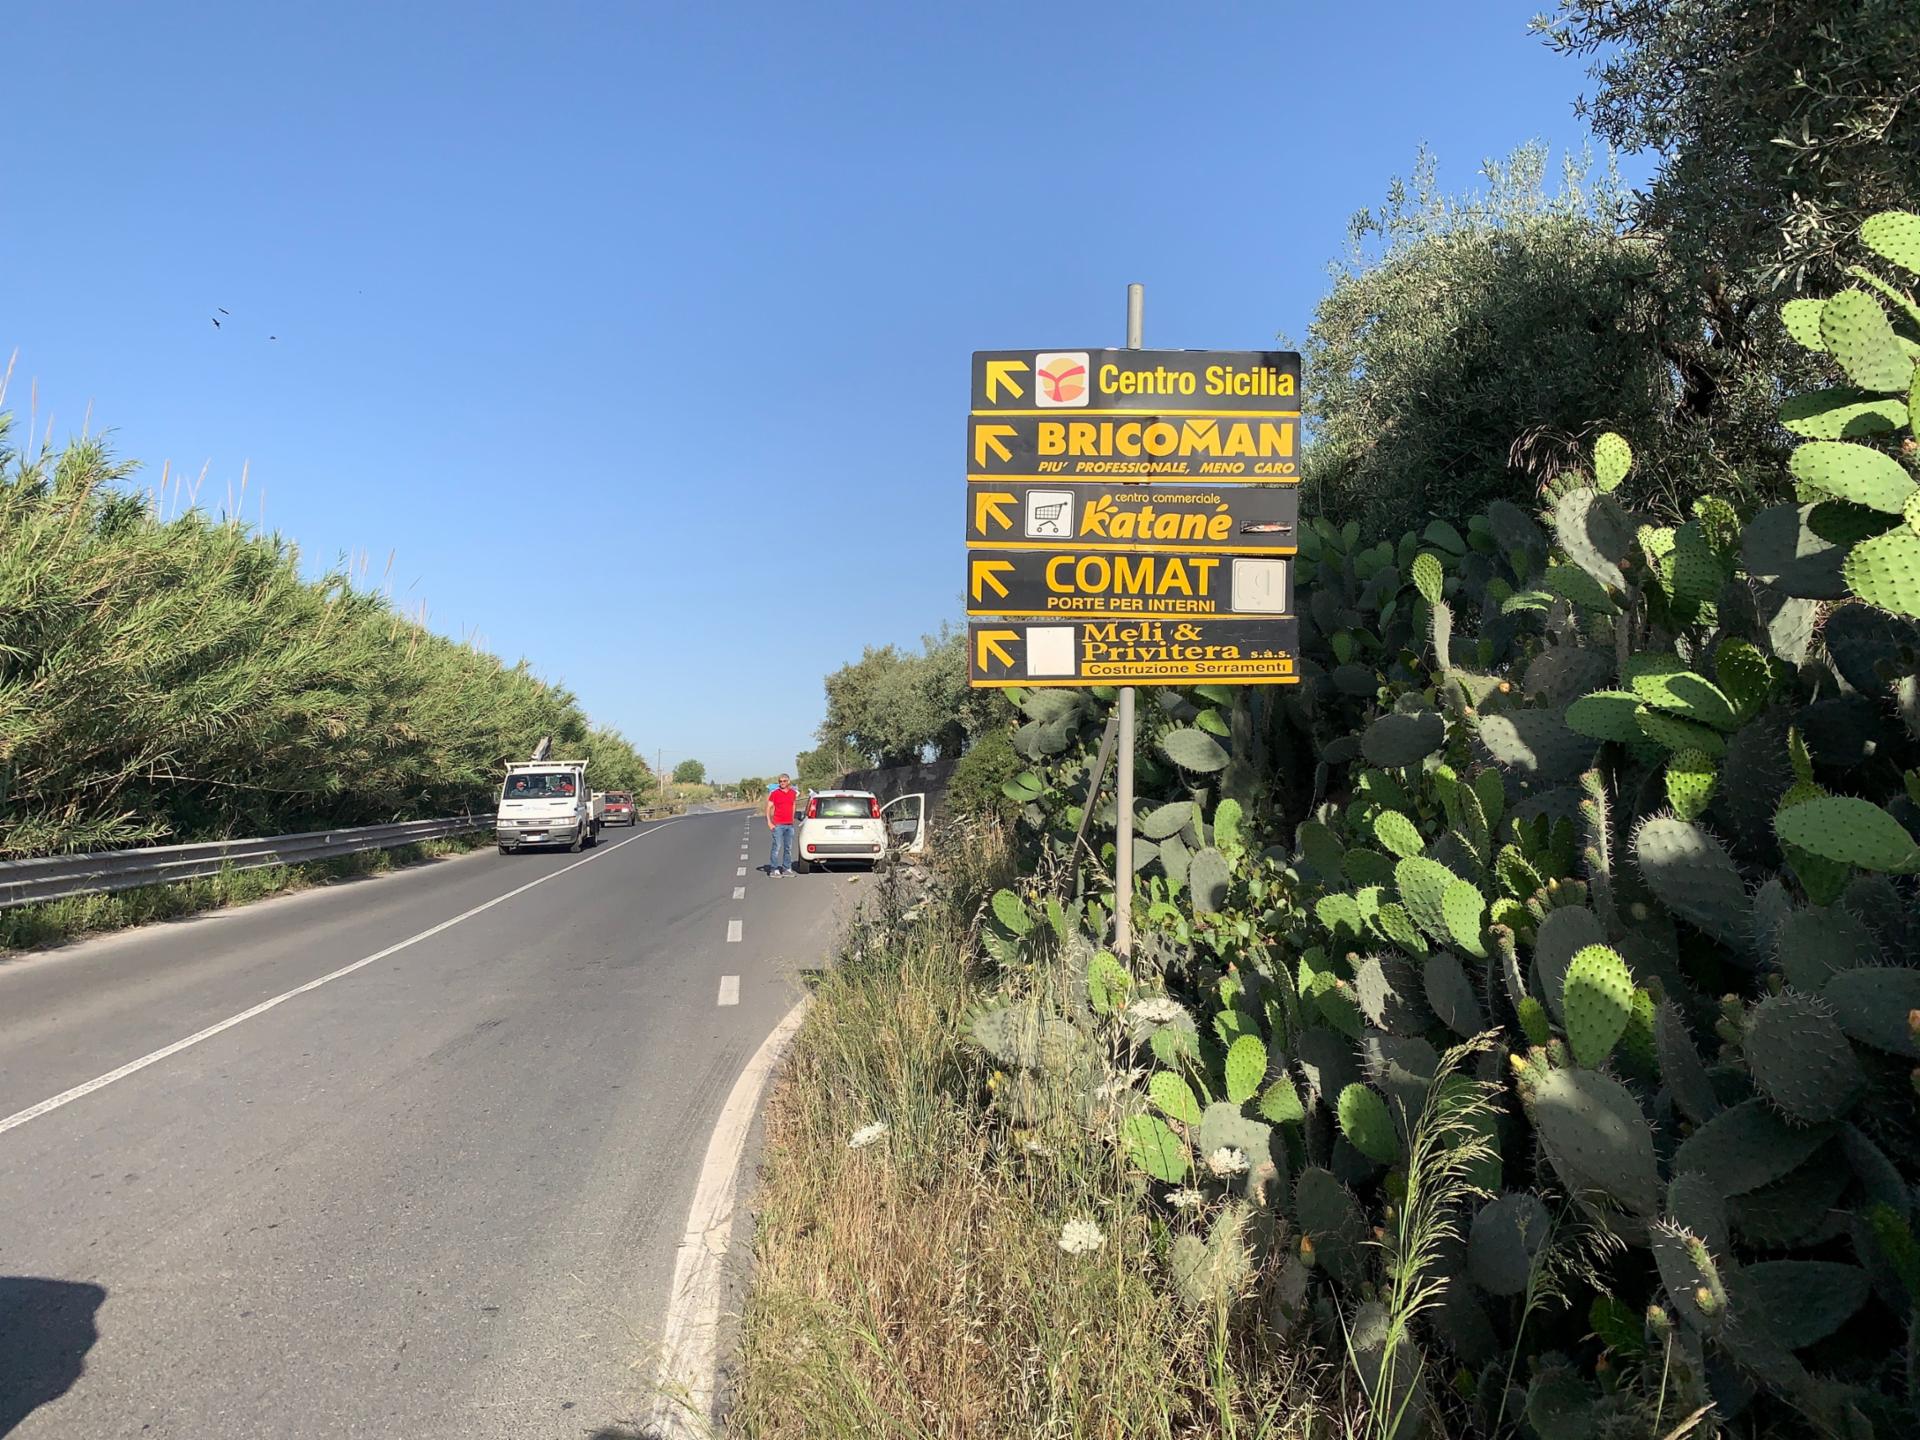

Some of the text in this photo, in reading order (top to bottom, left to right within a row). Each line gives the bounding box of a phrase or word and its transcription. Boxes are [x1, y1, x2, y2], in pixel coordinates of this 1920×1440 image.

[1099, 364, 1294, 396] Centro Sicilia
[1038, 419, 1294, 457] BRICOMAN
[1076, 462, 1191, 475] PROFESSIONALE,
[1200, 463, 1245, 473] MENO
[1254, 463, 1295, 473] CARO
[1115, 493, 1221, 504] centro commerciale
[1045, 556, 1219, 596] COMAT
[1047, 597, 1216, 612] PORTE PER INTERNI
[1082, 622, 1203, 642] Meli &
[1082, 641, 1291, 662] Privitera s.a.s.
[1089, 662, 1286, 675] Costruzione Serramenti
